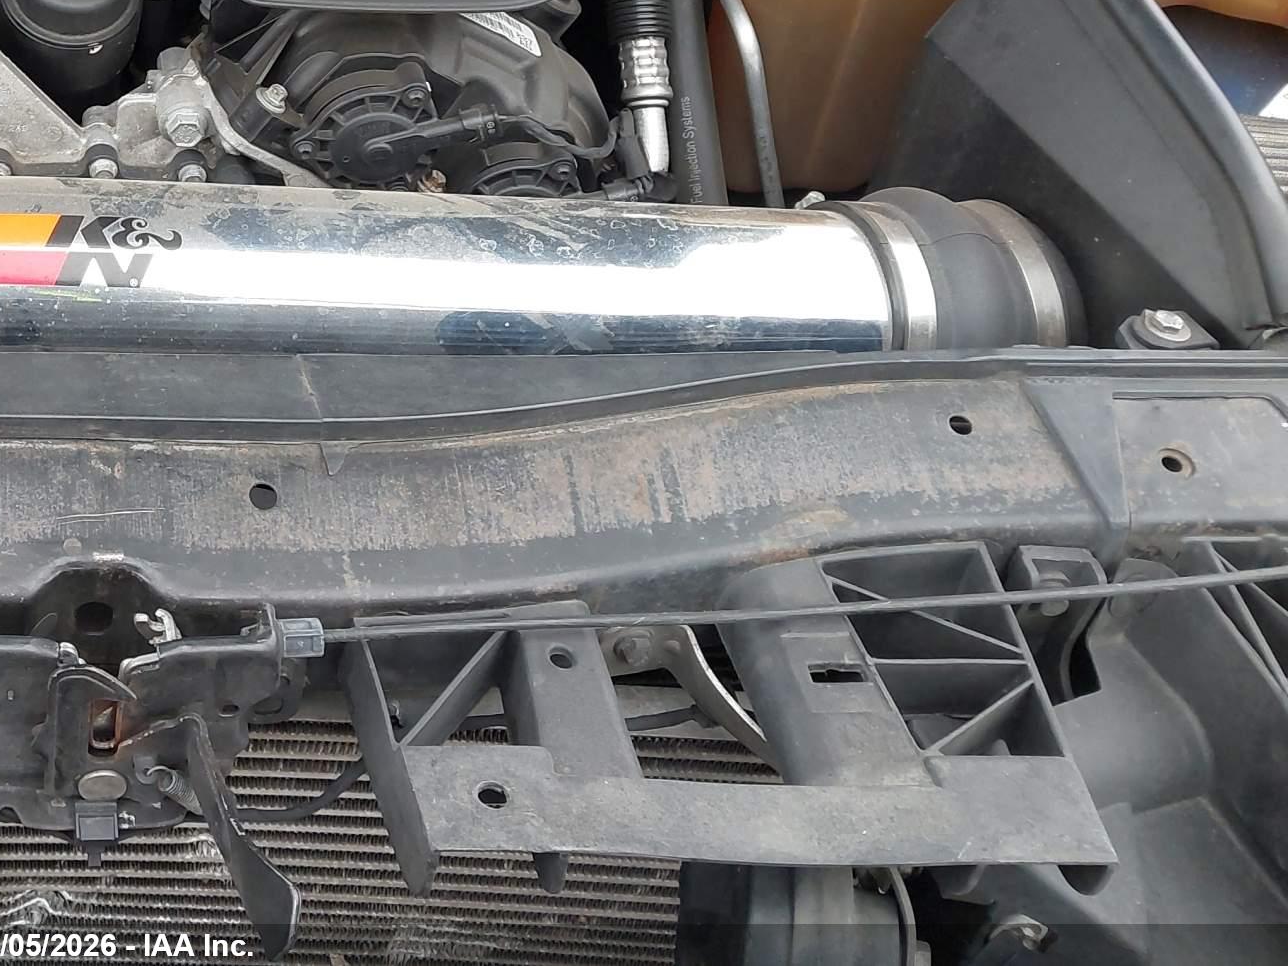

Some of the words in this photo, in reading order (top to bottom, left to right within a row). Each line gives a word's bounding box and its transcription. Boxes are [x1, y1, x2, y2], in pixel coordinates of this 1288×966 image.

[680, 95, 697, 139] Systems
[684, 140, 702, 182] Injection
[689, 183, 703, 204] Fuel
